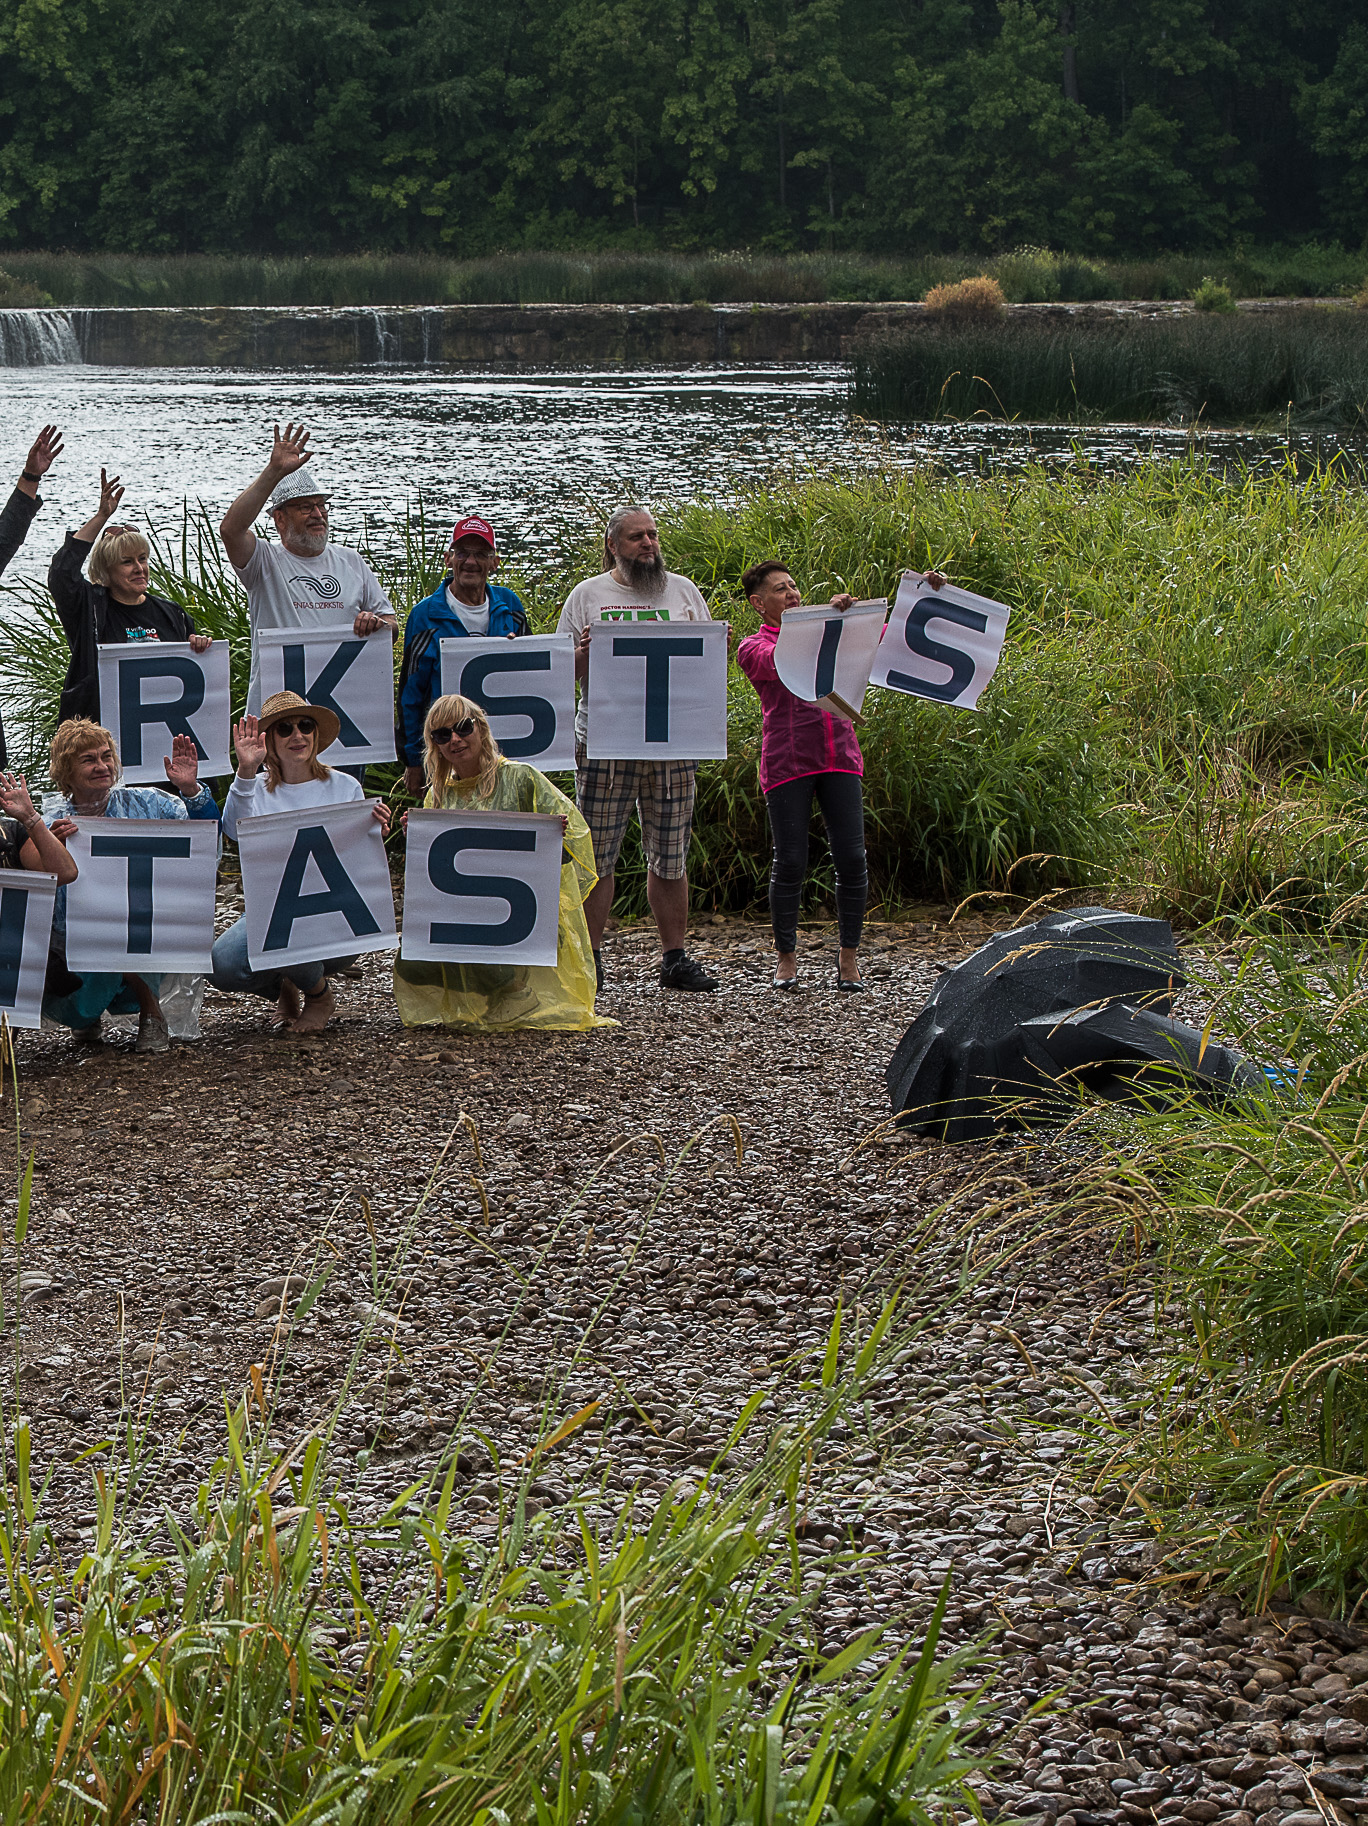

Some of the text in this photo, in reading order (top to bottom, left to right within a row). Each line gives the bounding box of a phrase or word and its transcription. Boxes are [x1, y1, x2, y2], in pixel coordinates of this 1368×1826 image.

[314, 601, 345, 609] DZIRKSTIS
[887, 597, 989, 702] S
[118, 656, 209, 767] R
[283, 640, 372, 748] K
[459, 651, 557, 759] S
[613, 638, 704, 743] T
[815, 619, 844, 700] I
[91, 836, 191, 955] T
[263, 826, 382, 952] A
[427, 828, 538, 947] S
